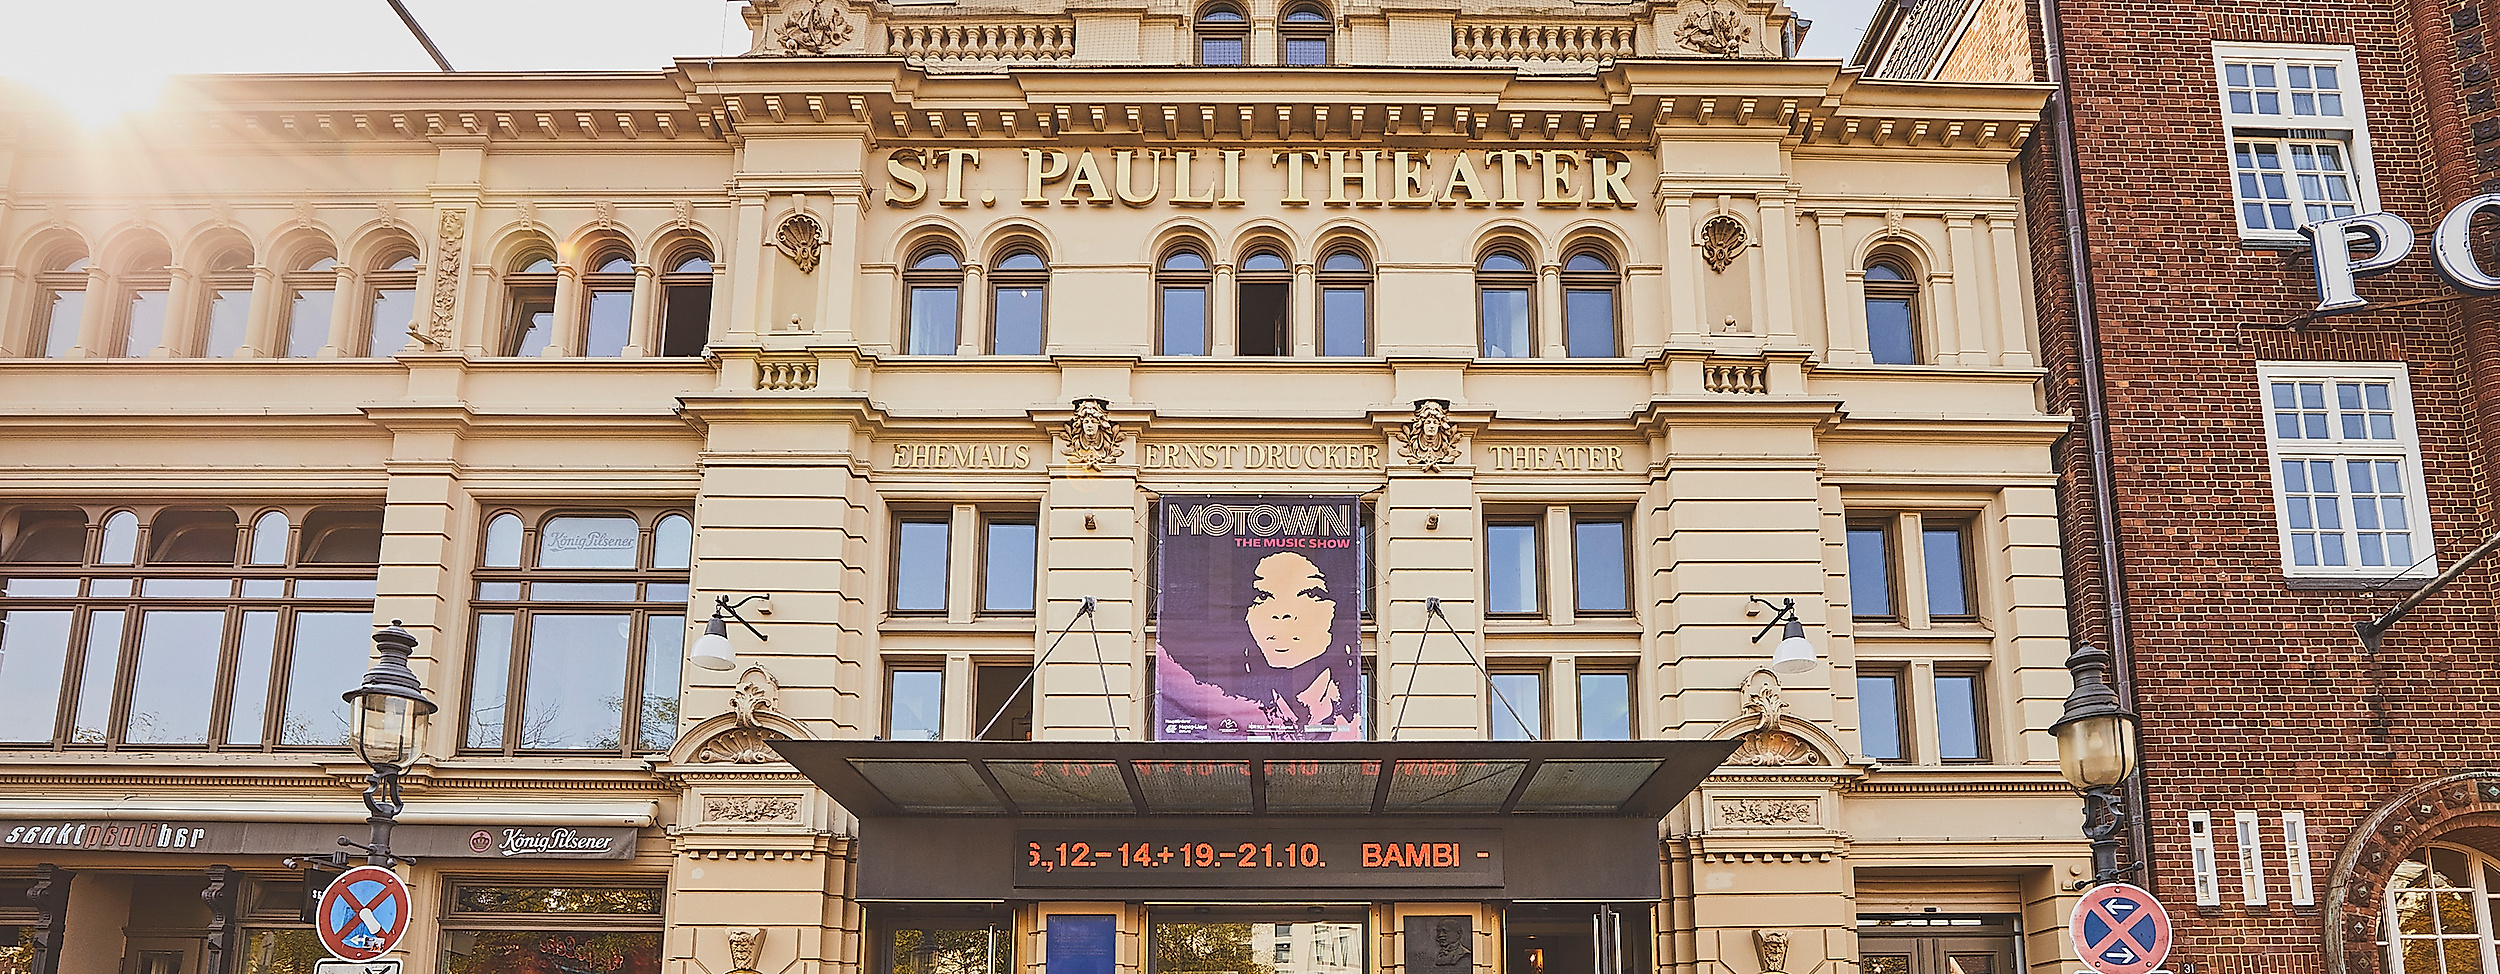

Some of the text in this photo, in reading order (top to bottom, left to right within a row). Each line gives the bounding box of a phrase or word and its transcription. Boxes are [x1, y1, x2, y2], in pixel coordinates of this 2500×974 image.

[885, 147, 1639, 208] ST. PAULI THEATER
[891, 443, 1624, 472] EHEMALS ERNST DRUCKER THEATER
[1168, 503, 1351, 537] MOTOWN
[548, 531, 635, 550] König Pilsener
[1234, 538, 1351, 549] THE MUSIC SHOW
[498, 827, 613, 852] König Pilsener
[1361, 841, 1461, 869] BAMBI
